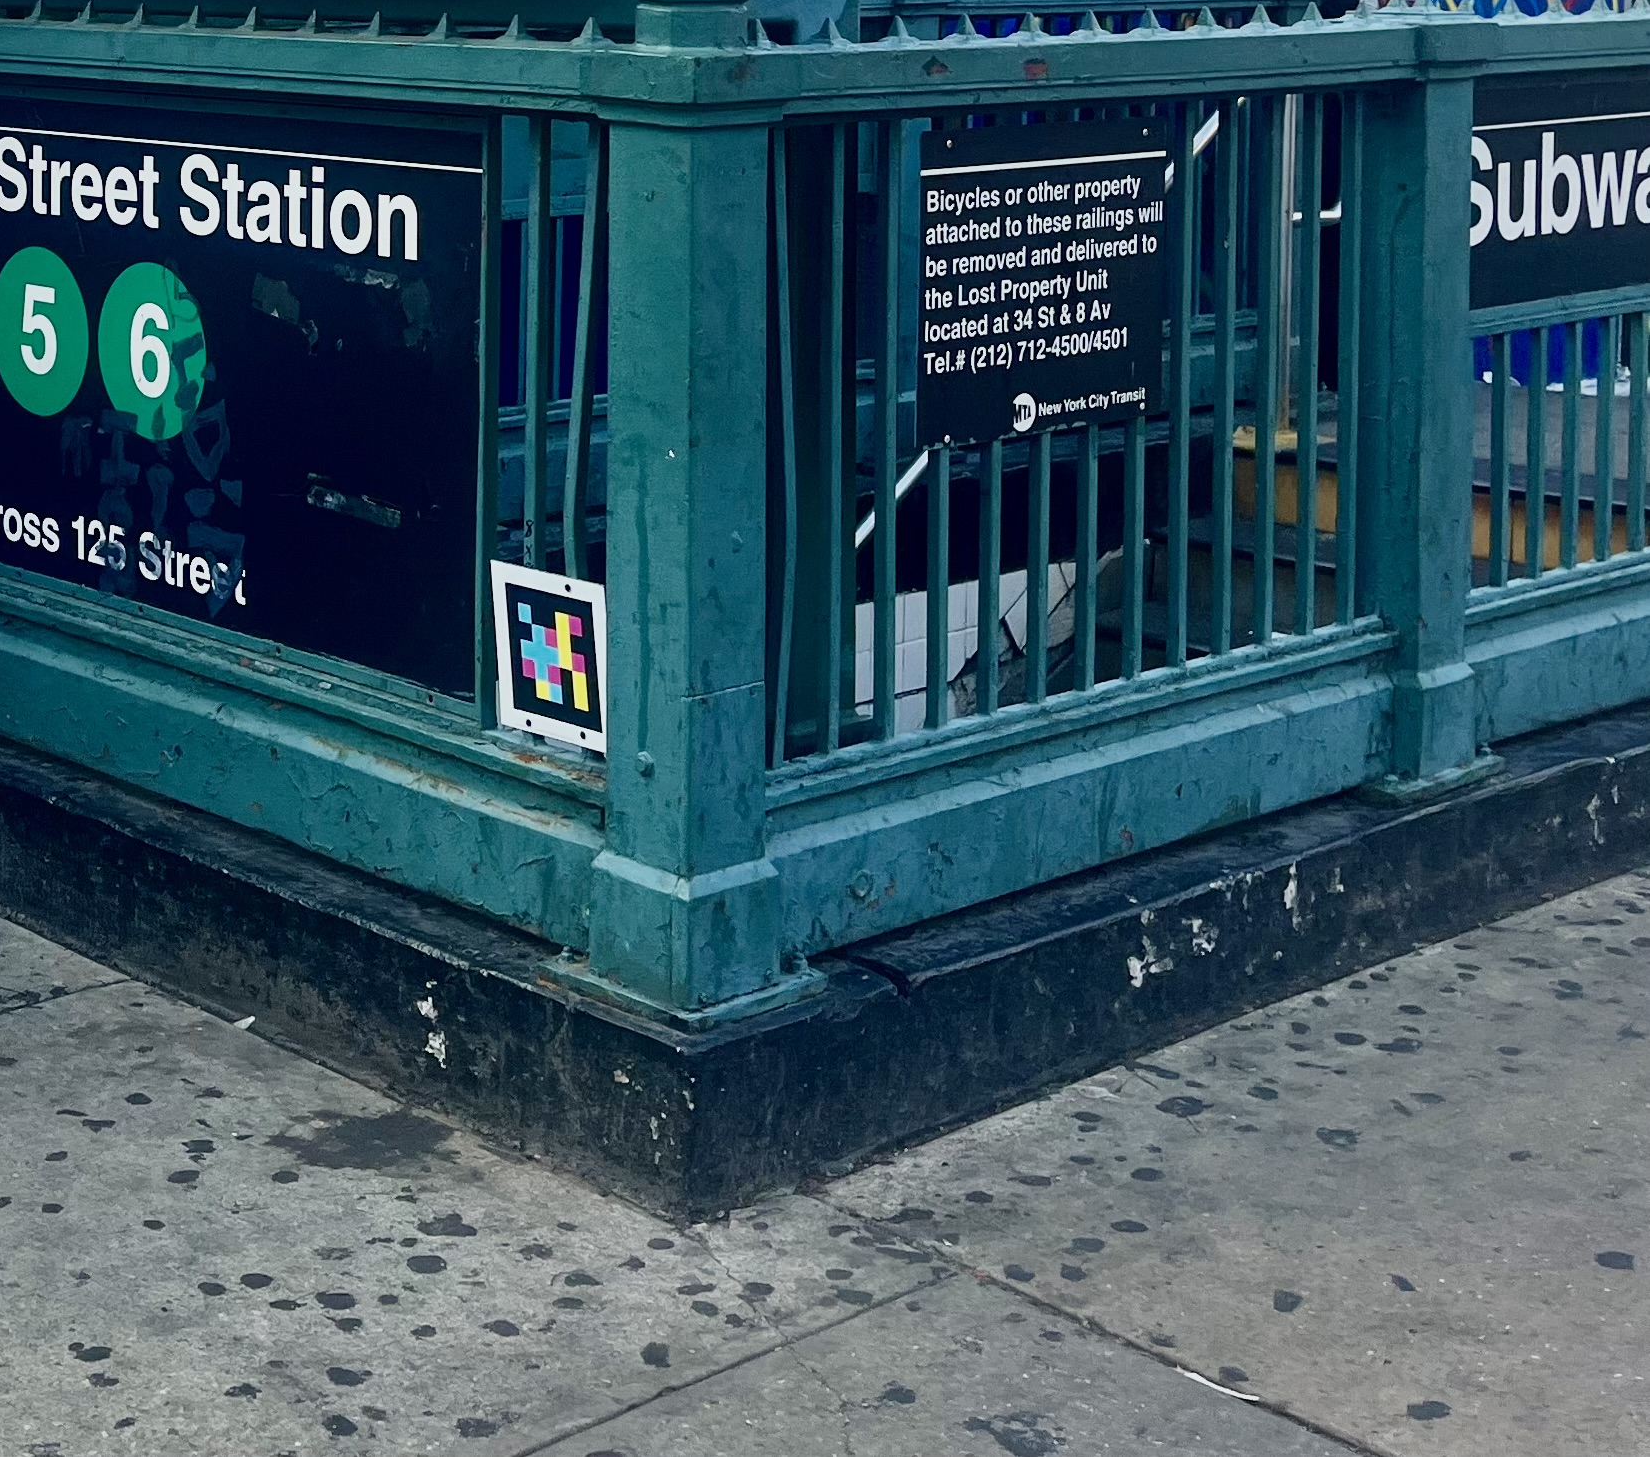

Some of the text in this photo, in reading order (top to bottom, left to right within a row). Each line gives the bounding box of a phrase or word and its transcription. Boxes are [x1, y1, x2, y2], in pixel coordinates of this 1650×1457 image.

[179, 153, 419, 261] Station
[926, 174, 1141, 216] Bicycles or other property
[925, 200, 1164, 246] attached to these railings will
[925, 233, 1158, 278] be removed and delivered to
[924, 268, 1109, 311] the Lost Property Unit
[20, 283, 58, 376] 5
[129, 302, 171, 399] 6
[924, 299, 1112, 343] located at 34 St & 8 Av
[923, 326, 1129, 375] Tel.# (212) 712-4500/4501
[1038, 386, 1146, 417] New York City Transit
[71, 515, 127, 572] 125
[138, 531, 247, 606] Street
